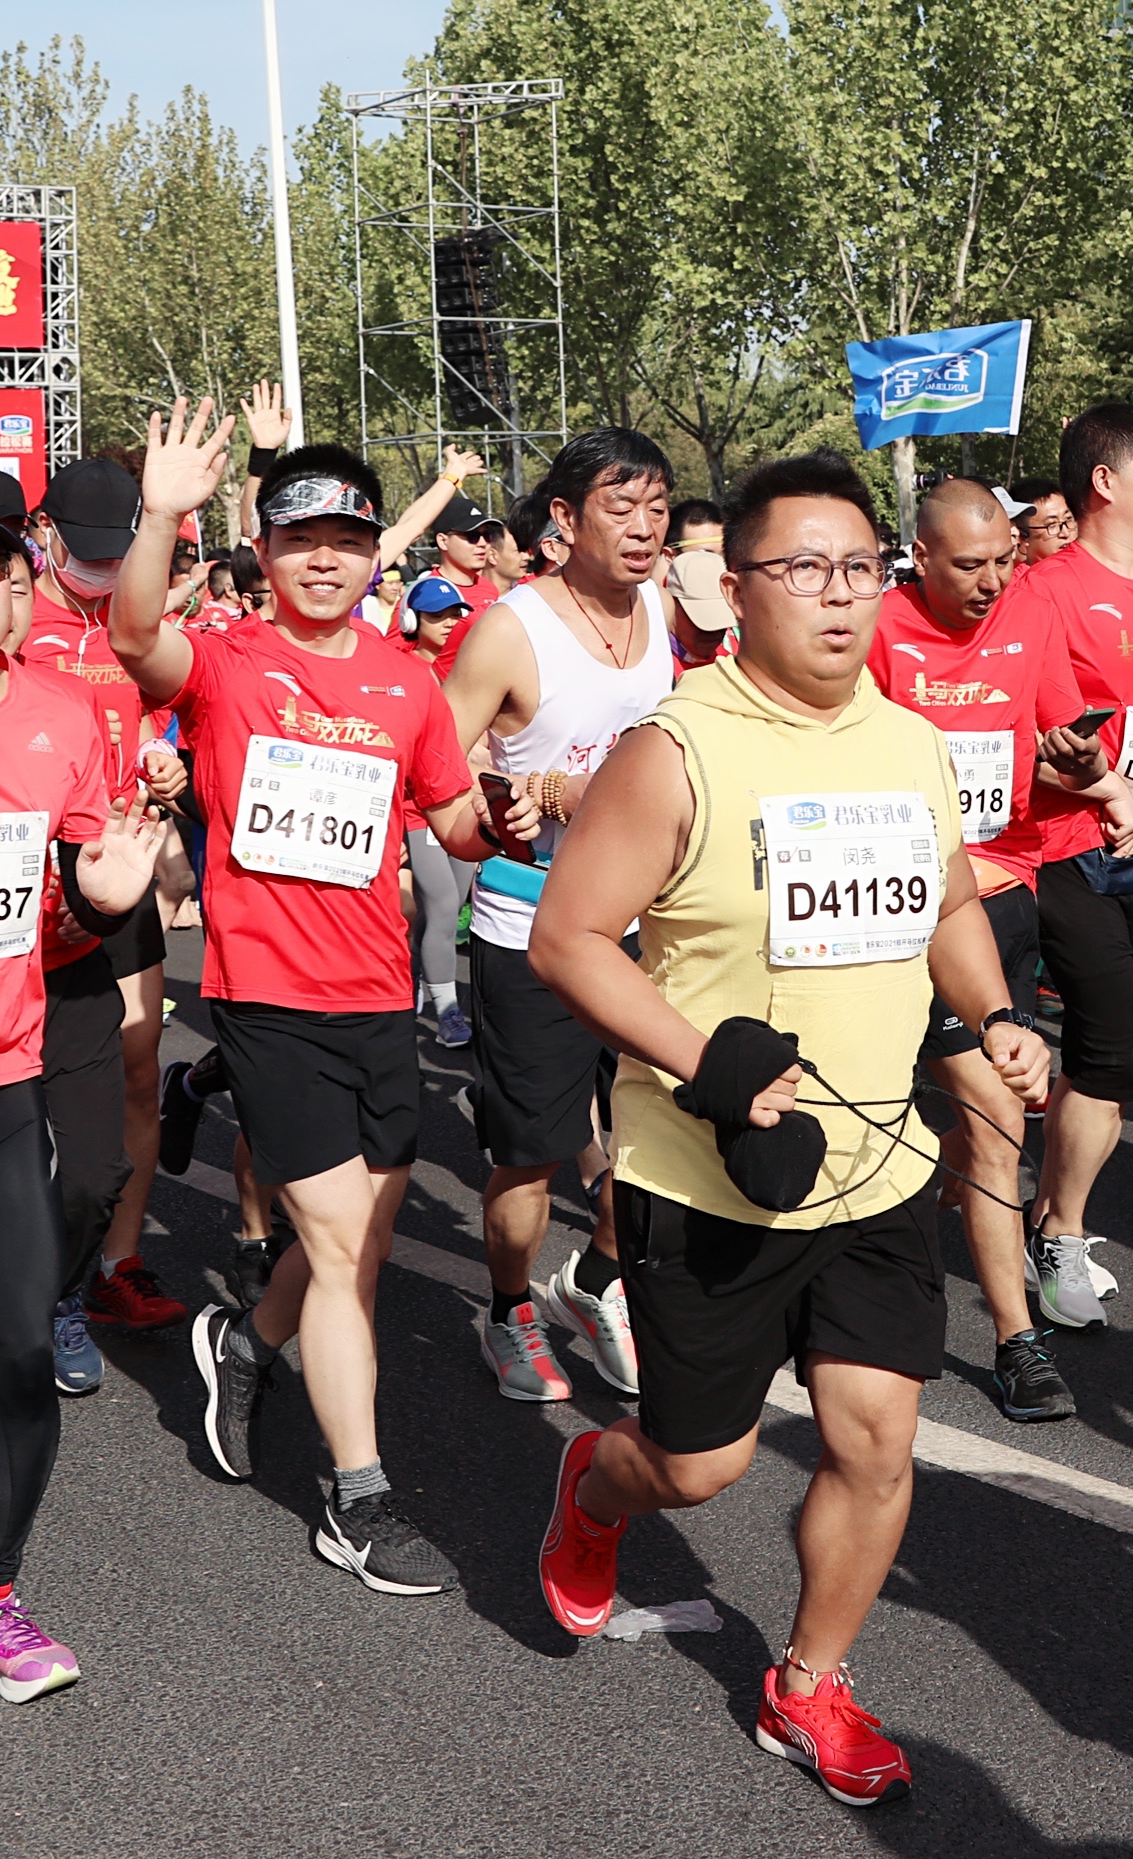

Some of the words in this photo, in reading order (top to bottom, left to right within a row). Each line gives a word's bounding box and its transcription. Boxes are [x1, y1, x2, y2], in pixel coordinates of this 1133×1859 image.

[309, 754, 382, 783] 君乐宝乳业
[793, 805, 826, 820] 君乐宝
[833, 803, 915, 826] 君乐宝乳业
[248, 802, 375, 855] D41801
[842, 847, 877, 866] 闵尧
[787, 875, 928, 922] D41139
